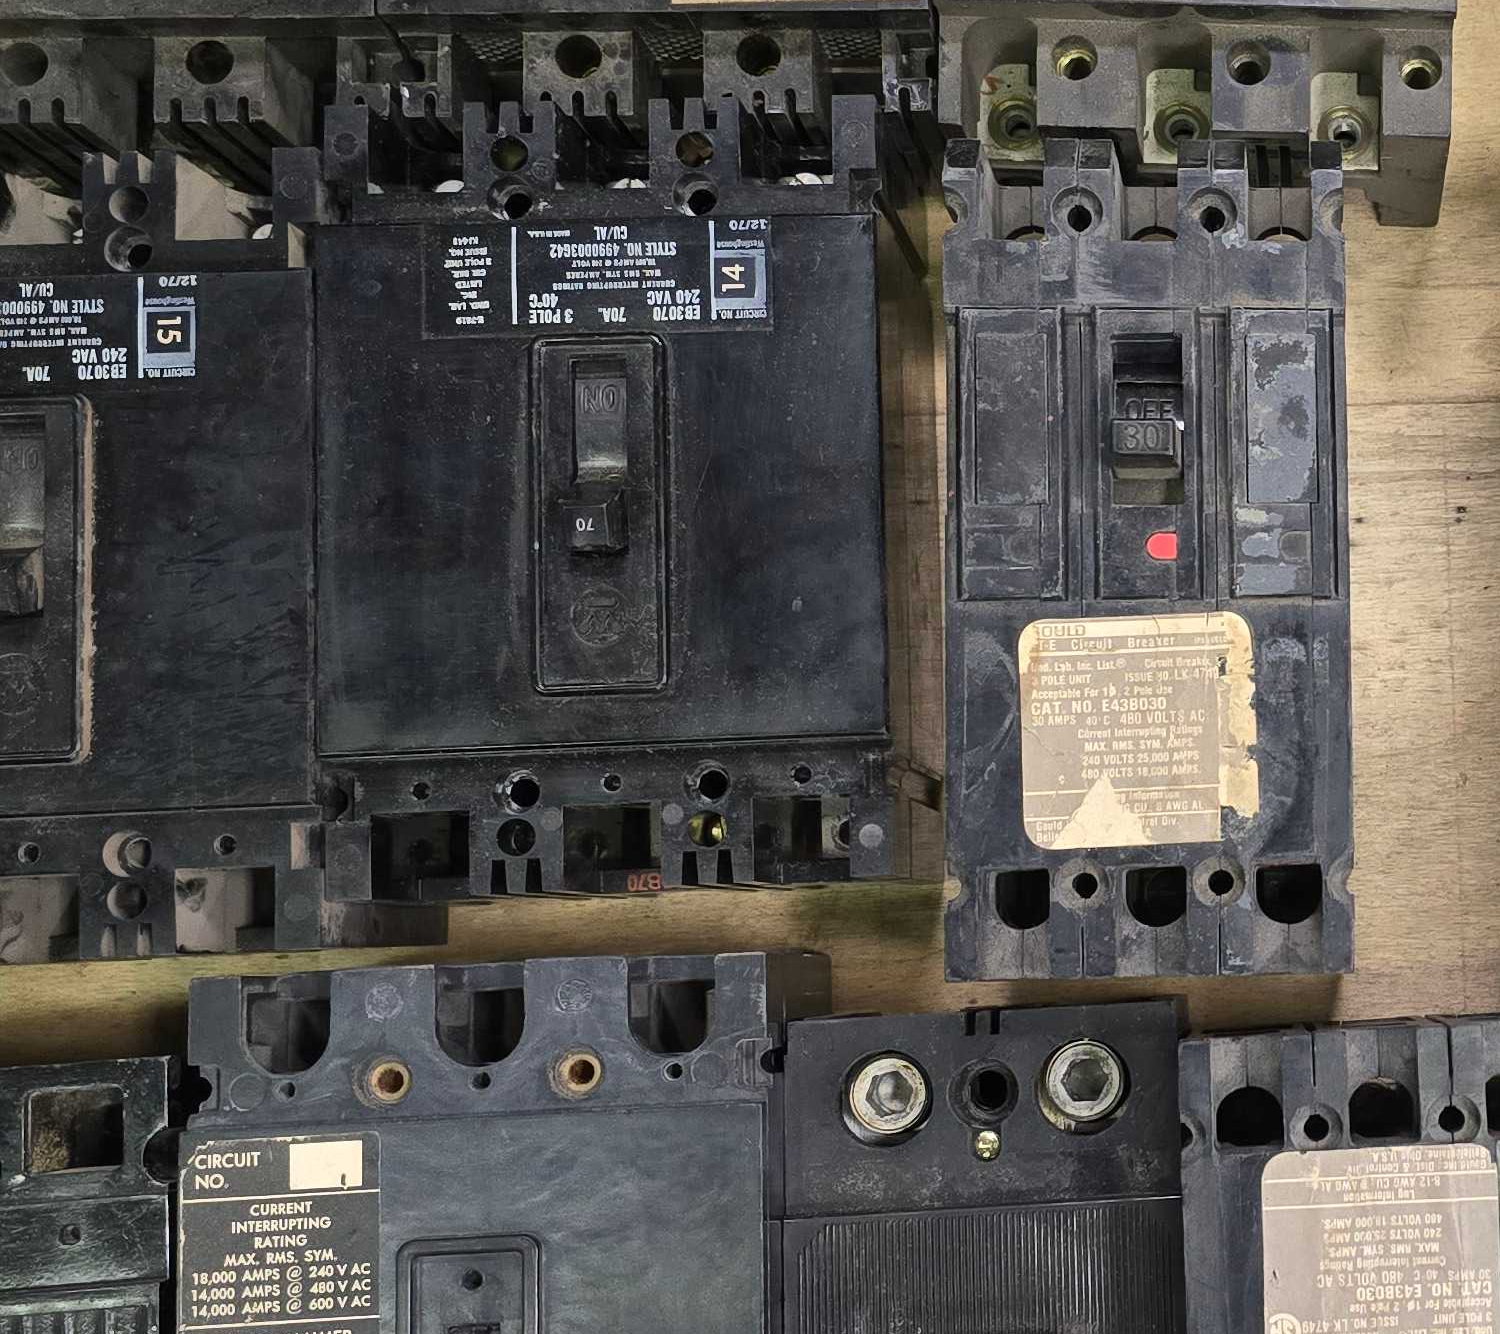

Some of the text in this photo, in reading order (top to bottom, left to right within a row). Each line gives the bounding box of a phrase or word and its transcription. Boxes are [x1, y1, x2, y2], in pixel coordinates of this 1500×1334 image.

[729, 219, 768, 230] 12/70
[594, 226, 627, 240] CU/AL
[624, 242, 643, 257] NO.
[645, 241, 676, 256] STYLE
[159, 275, 197, 287] 12/70
[721, 263, 746, 294] 14
[647, 290, 672, 305] VAC
[676, 289, 700, 304] 240
[529, 305, 700, 324] EB3070 70A. 3 POLE
[156, 315, 182, 345] 15
[22, 363, 127, 382] EB3070 70A.
[576, 518, 595, 531] 70
[1031, 702, 1065, 715] CAT.
[1071, 700, 1097, 714] NO.
[195, 1151, 261, 1169] CIRCUIT
[195, 1174, 229, 1190] NO.
[250, 1201, 312, 1216] CURRENT
[231, 1216, 331, 1234] INTERRUPTING
[254, 1234, 307, 1249] RATING
[224, 1248, 338, 1267] MAX. RMS. SYM.
[192, 1263, 371, 1286] 18,000 AMPS @ 240 V AC
[191, 1279, 371, 1302] 14,000 AMPS @ 480 V AC
[1427, 1282, 1452, 1297] NO.
[1457, 1280, 1492, 1295] CAT.
[191, 1295, 371, 1320] 14,000 AMPS @ 600 V AC
